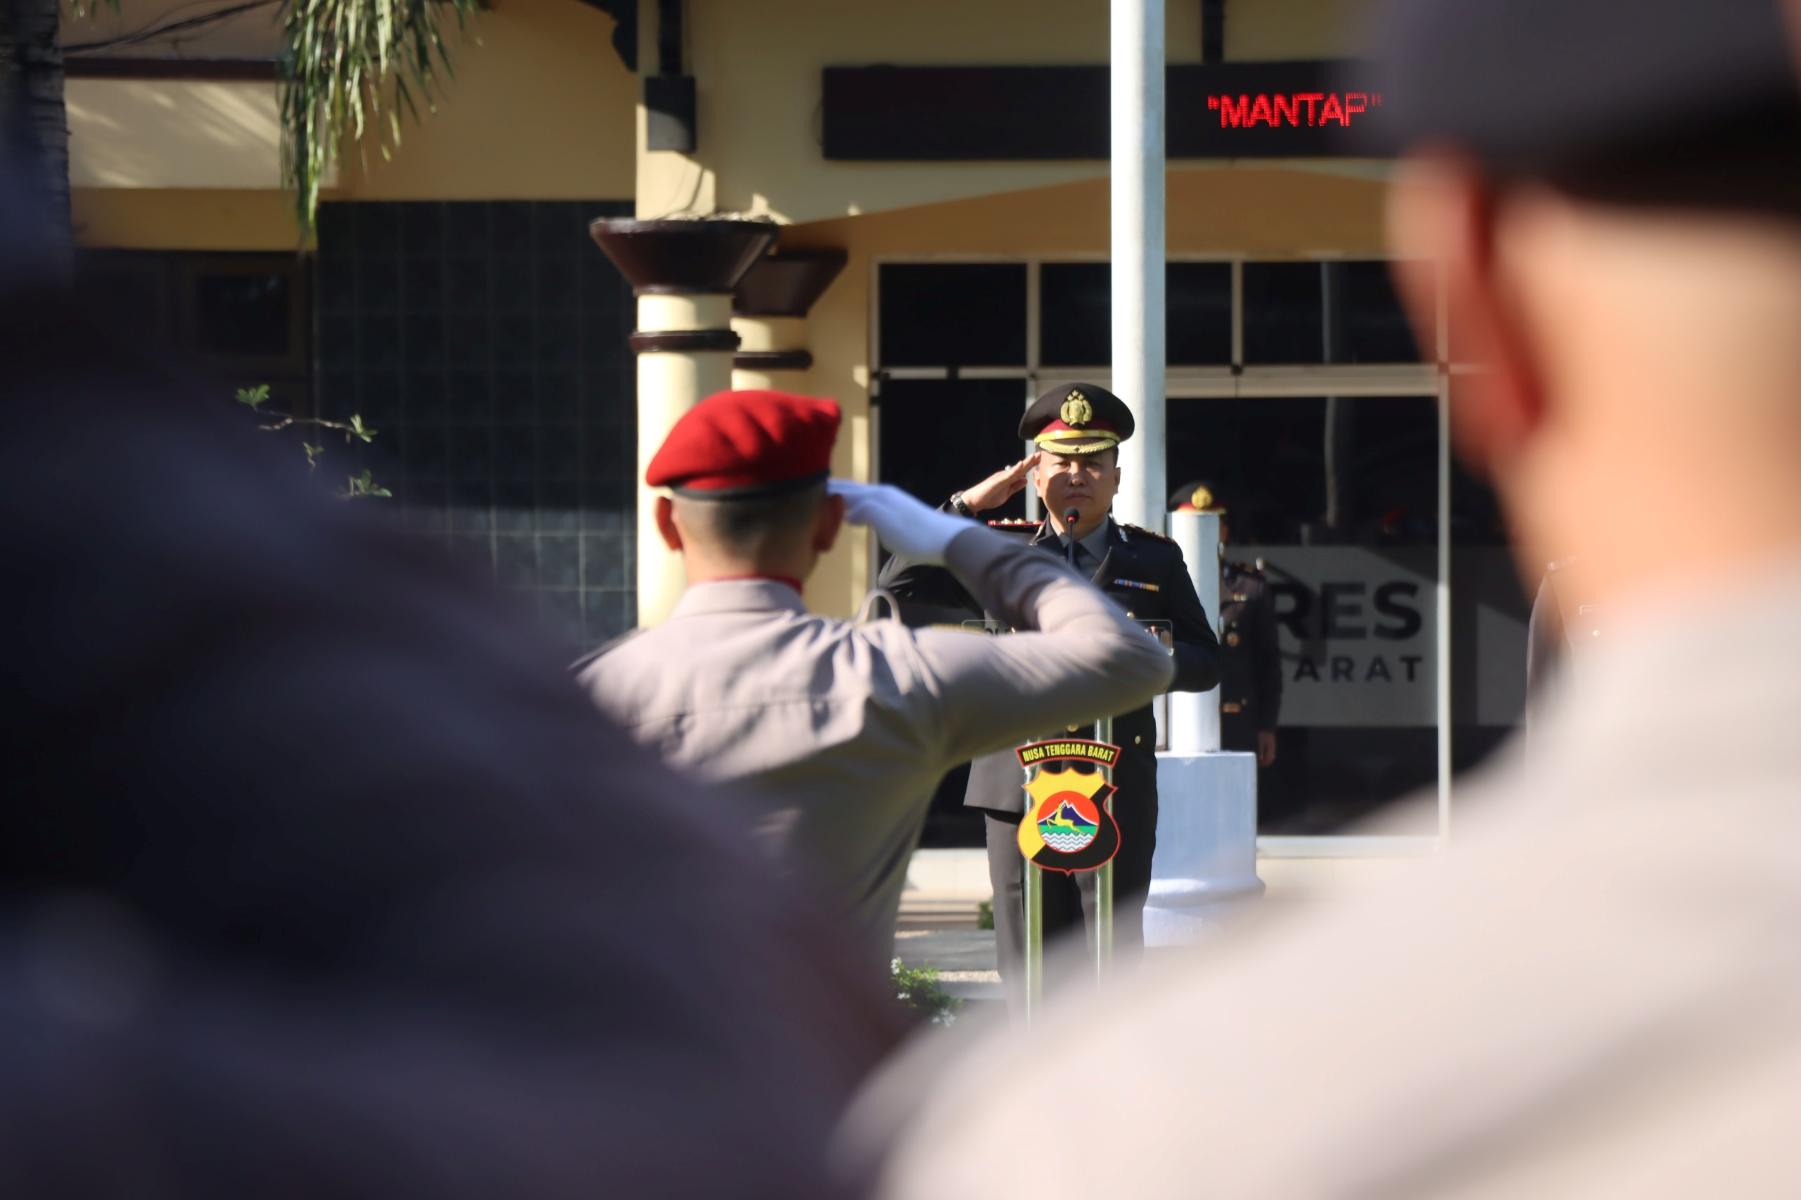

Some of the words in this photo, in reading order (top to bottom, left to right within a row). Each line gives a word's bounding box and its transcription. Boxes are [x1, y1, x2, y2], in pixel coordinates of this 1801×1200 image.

[1022, 747, 1045, 762] NUSA
[1045, 743, 1086, 757] TENGGARA
[1087, 745, 1115, 762] BARAT
